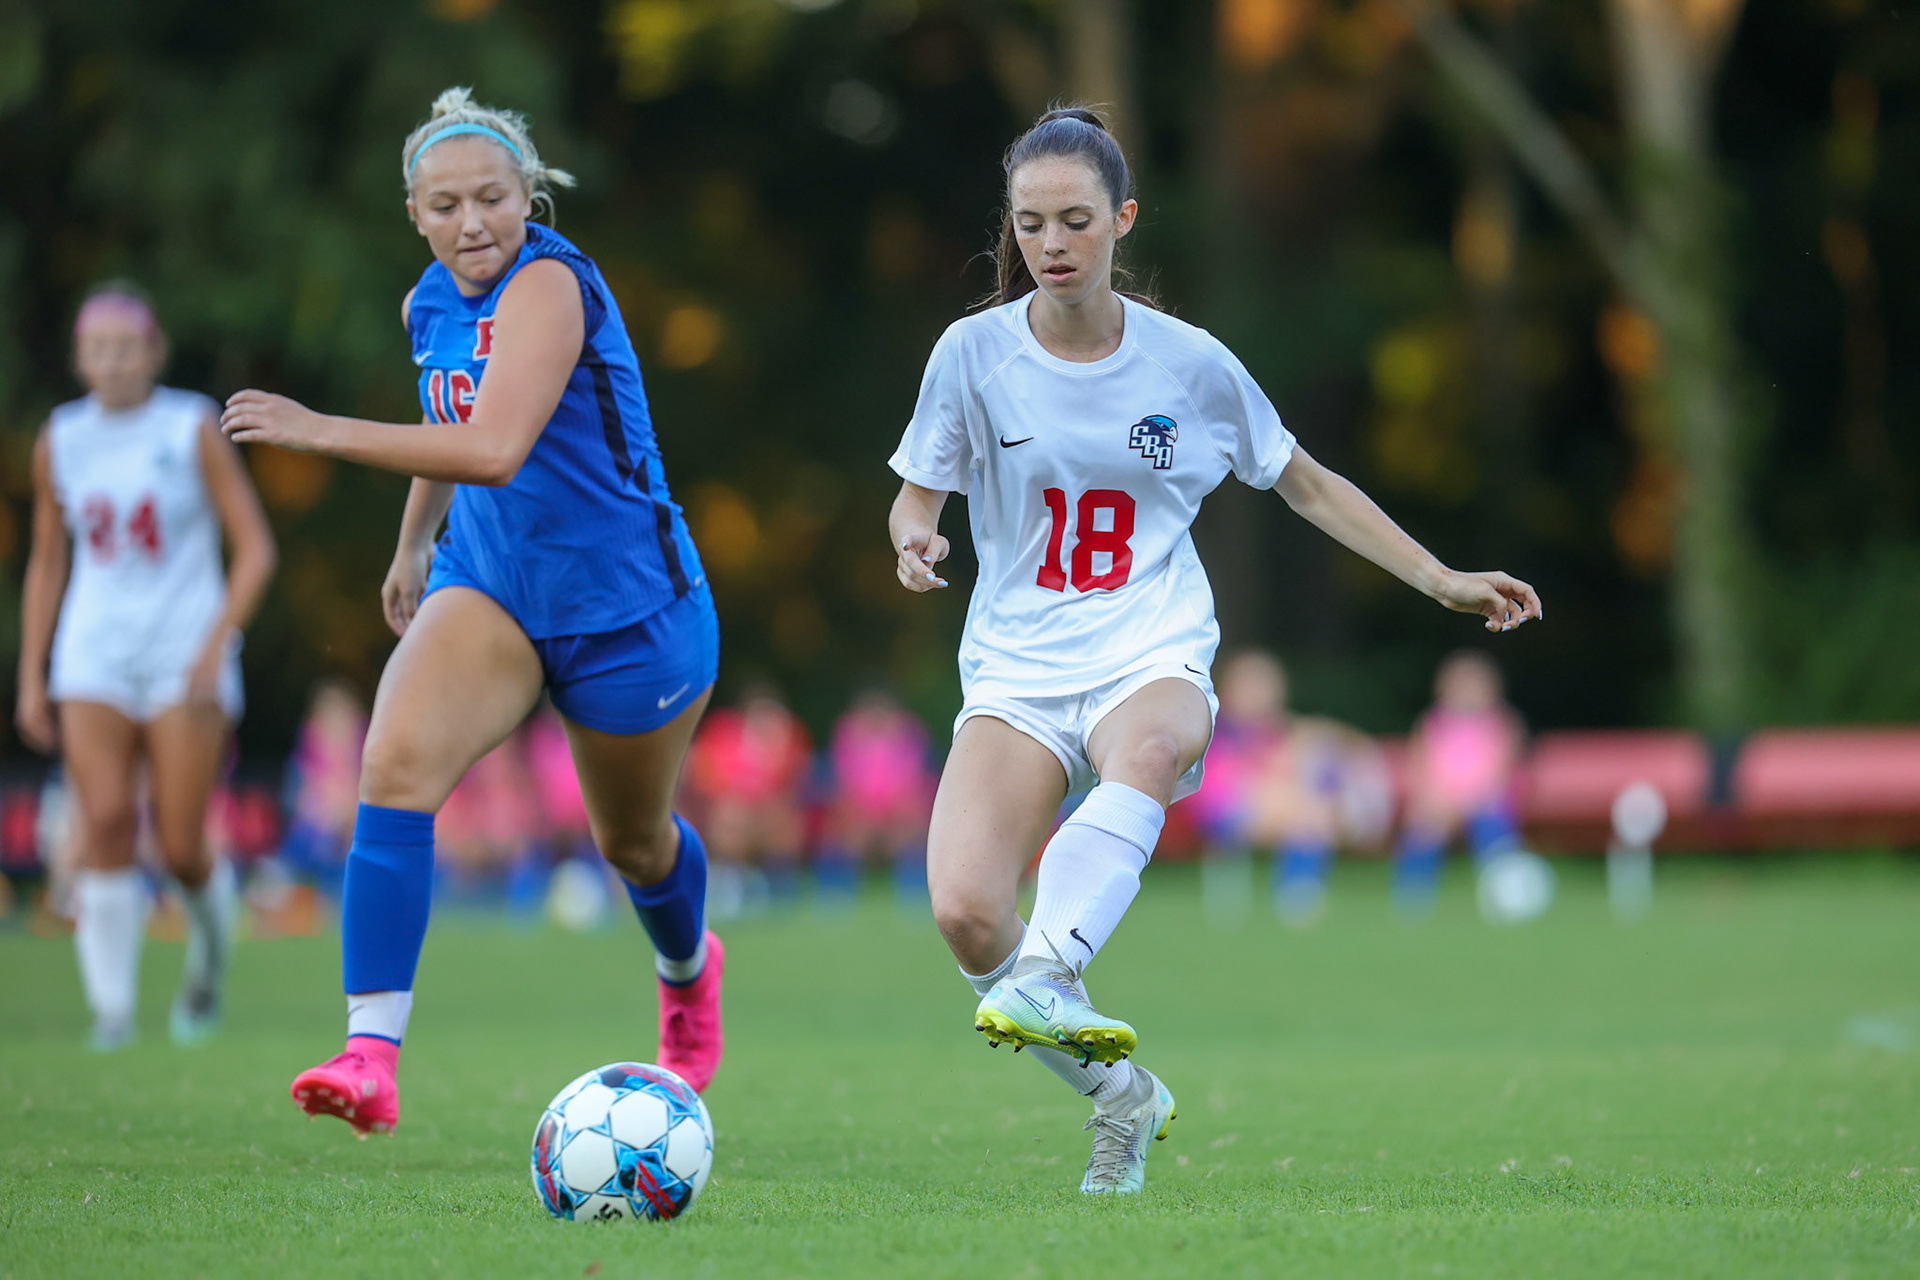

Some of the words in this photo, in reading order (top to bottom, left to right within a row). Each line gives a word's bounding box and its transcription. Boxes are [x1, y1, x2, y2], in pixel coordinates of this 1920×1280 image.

[1129, 424, 1173, 469] SBA
[83, 493, 163, 563] 24
[1037, 487, 1136, 593] 18
